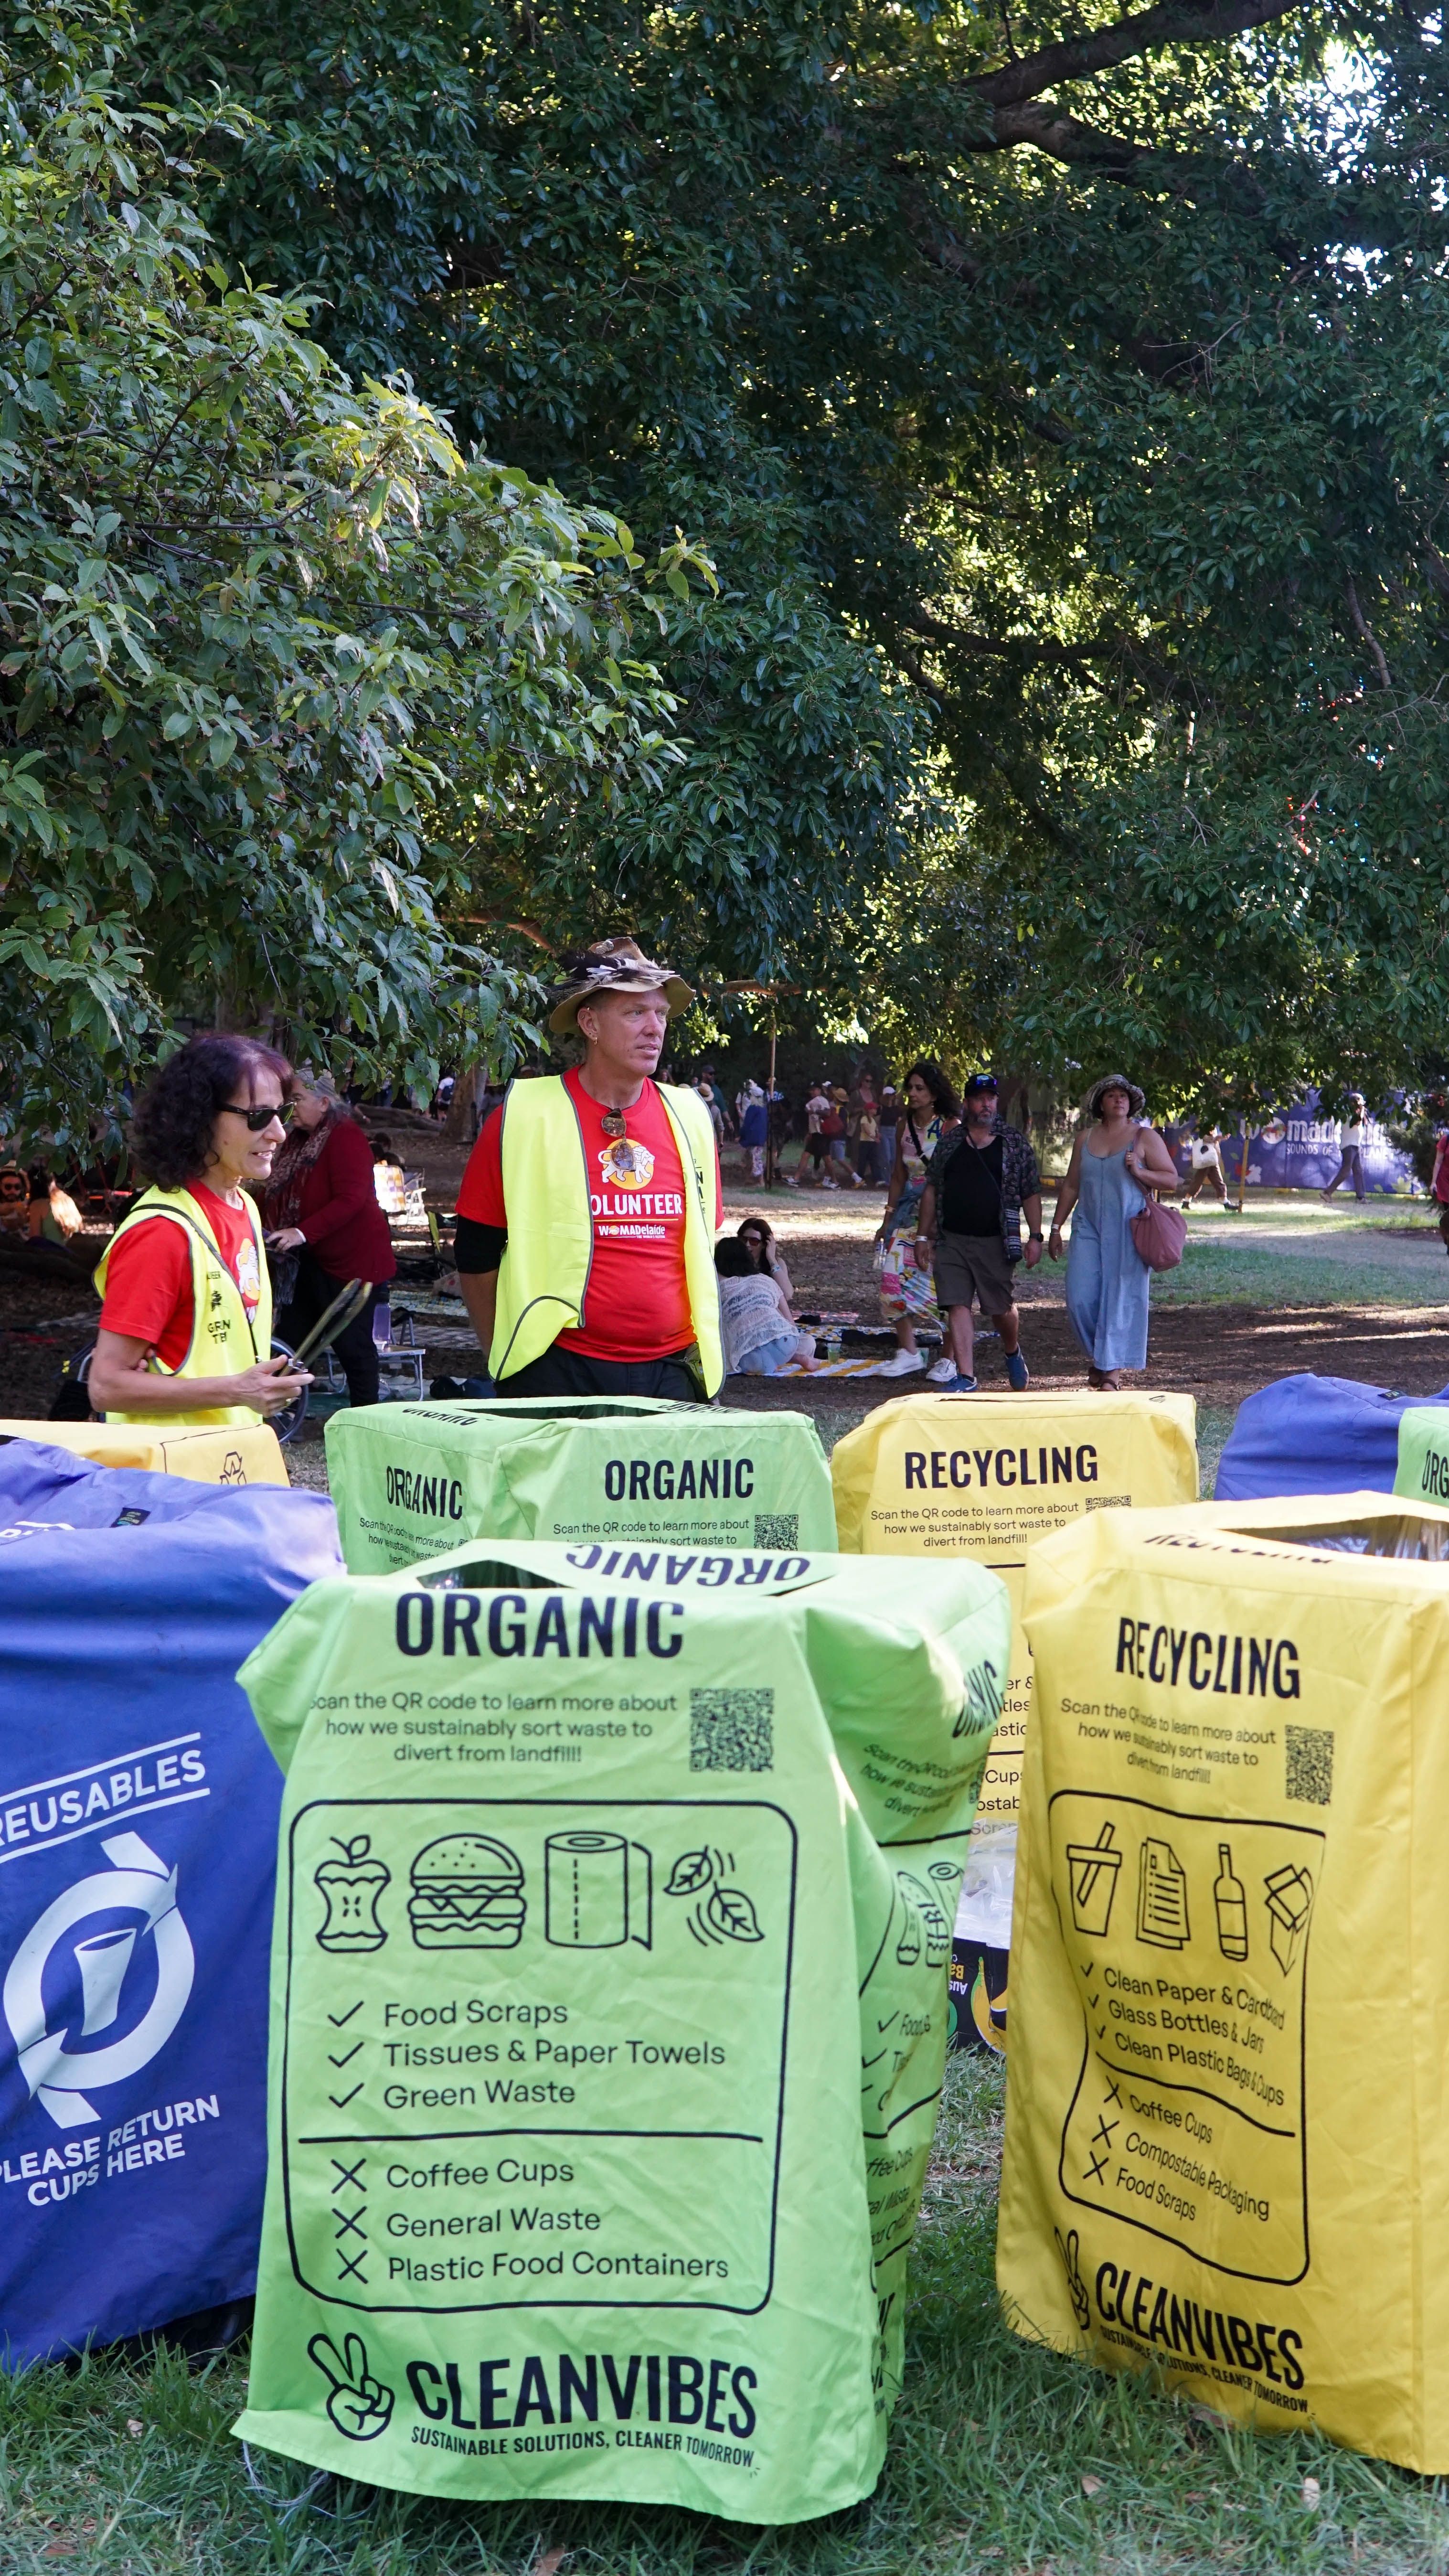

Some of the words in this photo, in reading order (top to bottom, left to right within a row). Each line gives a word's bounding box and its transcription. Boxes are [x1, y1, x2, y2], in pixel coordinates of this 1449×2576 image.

[1287, 1144, 1318, 1155] SOUNDS
[1322, 1144, 1333, 1155] OF
[591, 1194, 682, 1216] OLUNTEER
[605, 1459, 754, 1501] ORGANIC
[905, 1444, 1098, 1489] RECYCLING
[386, 1465, 463, 1520] ORGANIC
[360, 1518, 379, 1529] Scan
[554, 1524, 580, 1534] Scan
[582, 1522, 600, 1533] the
[603, 1522, 619, 1535] QR
[621, 1521, 646, 1532] code
[649, 1521, 661, 1531] to
[663, 1520, 689, 1531] learn
[691, 1520, 718, 1530] more
[720, 1519, 750, 1529] about
[871, 1510, 898, 1520] Scan
[900, 1509, 919, 1519] the
[922, 1508, 939, 1520] QR
[942, 1507, 969, 1518] code
[971, 1507, 983, 1517] to
[986, 1506, 1012, 1516] learn
[1016, 1506, 1044, 1516] more
[1047, 1503, 1079, 1514] about
[884, 1525, 907, 1534] how
[910, 1524, 926, 1533] we
[928, 1521, 991, 1533] sustainably
[994, 1519, 1017, 1529] sort
[1020, 1518, 1052, 1528] waste
[1054, 1518, 1066, 1528] to
[369, 1534, 383, 1545] how
[416, 1536, 434, 1546] more
[435, 1539, 454, 1550] about
[670, 1536, 691, 1546] sort
[693, 1535, 724, 1546] waste
[726, 1535, 737, 1545] to
[924, 1537, 956, 1547] divert
[959, 1535, 985, 1546] from
[988, 1534, 1027, 1545] landfill!
[565, 1544, 810, 1586] ORGANIC
[395, 1593, 684, 1659] ORGANIC
[1116, 1617, 1300, 1699] RECYCLING
[356, 1693, 387, 1709] the
[393, 1692, 423, 1712] QR
[428, 1694, 476, 1709] code
[482, 1696, 502, 1709] to
[508, 1694, 557, 1710] learn
[562, 1698, 614, 1711] more
[619, 1695, 677, 1711] about
[326, 1720, 365, 1735] how
[370, 1721, 398, 1735] we
[404, 1720, 516, 1739] sustainably
[522, 1721, 562, 1736] sort
[568, 1723, 627, 1737] waste
[632, 1722, 652, 1737] to
[1061, 1699, 1099, 1715] Scan
[1104, 1703, 1127, 1719] the
[1159, 1718, 1169, 1731] to
[1172, 1719, 1200, 1737] learn
[1203, 1726, 1232, 1741] more
[1236, 1728, 1277, 1745] about
[394, 1744, 453, 1762] divert
[458, 1745, 505, 1762] from
[511, 1745, 582, 1763] landfill!
[1078, 1722, 1109, 1739] how
[1113, 1729, 1131, 1742] we
[1179, 1744, 1203, 1760] sort
[1205, 1750, 1240, 1765] waste
[1243, 1753, 1259, 1766] to
[0, 1750, 205, 1847] EUSABLES
[384, 2001, 457, 2027] Food
[466, 1999, 568, 2029] Scraps
[1104, 1967, 1153, 1997] Clean
[1157, 1979, 1216, 2005] Paper
[1222, 1986, 1233, 2005] &
[1236, 1989, 1286, 2031] Cardboard
[1108, 1999, 1157, 2027] Glass
[1161, 2009, 1234, 2038] Bottles
[1231, 2022, 1238, 2042] &
[1241, 2026, 1265, 2054] Jars
[384, 2042, 499, 2067] Tissues
[508, 2039, 527, 2062] &
[535, 2039, 618, 2068] Paper
[625, 2040, 725, 2064] Towels
[1115, 2032, 1162, 2062] Clean
[1168, 2043, 1224, 2073] Plastic
[1226, 2057, 1251, 2089] Bags
[1249, 2072, 1256, 2092] &
[1256, 2076, 1285, 2107] Cups
[384, 2085, 476, 2109] Green
[485, 2079, 575, 2103] Waste
[1129, 2095, 1182, 2128] Coffee
[1185, 2111, 1213, 2144] Cups
[0, 2137, 100, 2183] LEASE
[107, 2095, 220, 2152] RETURN
[28, 2164, 100, 2206] CUPS
[107, 2133, 185, 2177] HERE
[387, 2162, 489, 2188] Coffee
[497, 2159, 574, 2187] Cups
[1126, 2132, 1206, 2187] Compostable
[1207, 2170, 1269, 2222] Packaging
[1116, 2167, 1155, 2199] Food
[1156, 2183, 1196, 2222] Scraps
[387, 2210, 501, 2237] General
[510, 2207, 600, 2231] Waste
[388, 2256, 484, 2282] Plastic
[493, 2251, 564, 2276] Food
[573, 2251, 729, 2278] Containers
[1096, 2262, 1305, 2390] CLEANVIBES
[405, 2354, 758, 2439] CLEANVIBES
[1254, 2381, 1309, 2414] TOMORROW
[411, 2426, 509, 2456] SUSTAINABLE
[513, 2430, 610, 2454] SOLUTIONS,
[616, 2430, 682, 2452] CLEANER
[686, 2437, 755, 2468] TOMORROW
